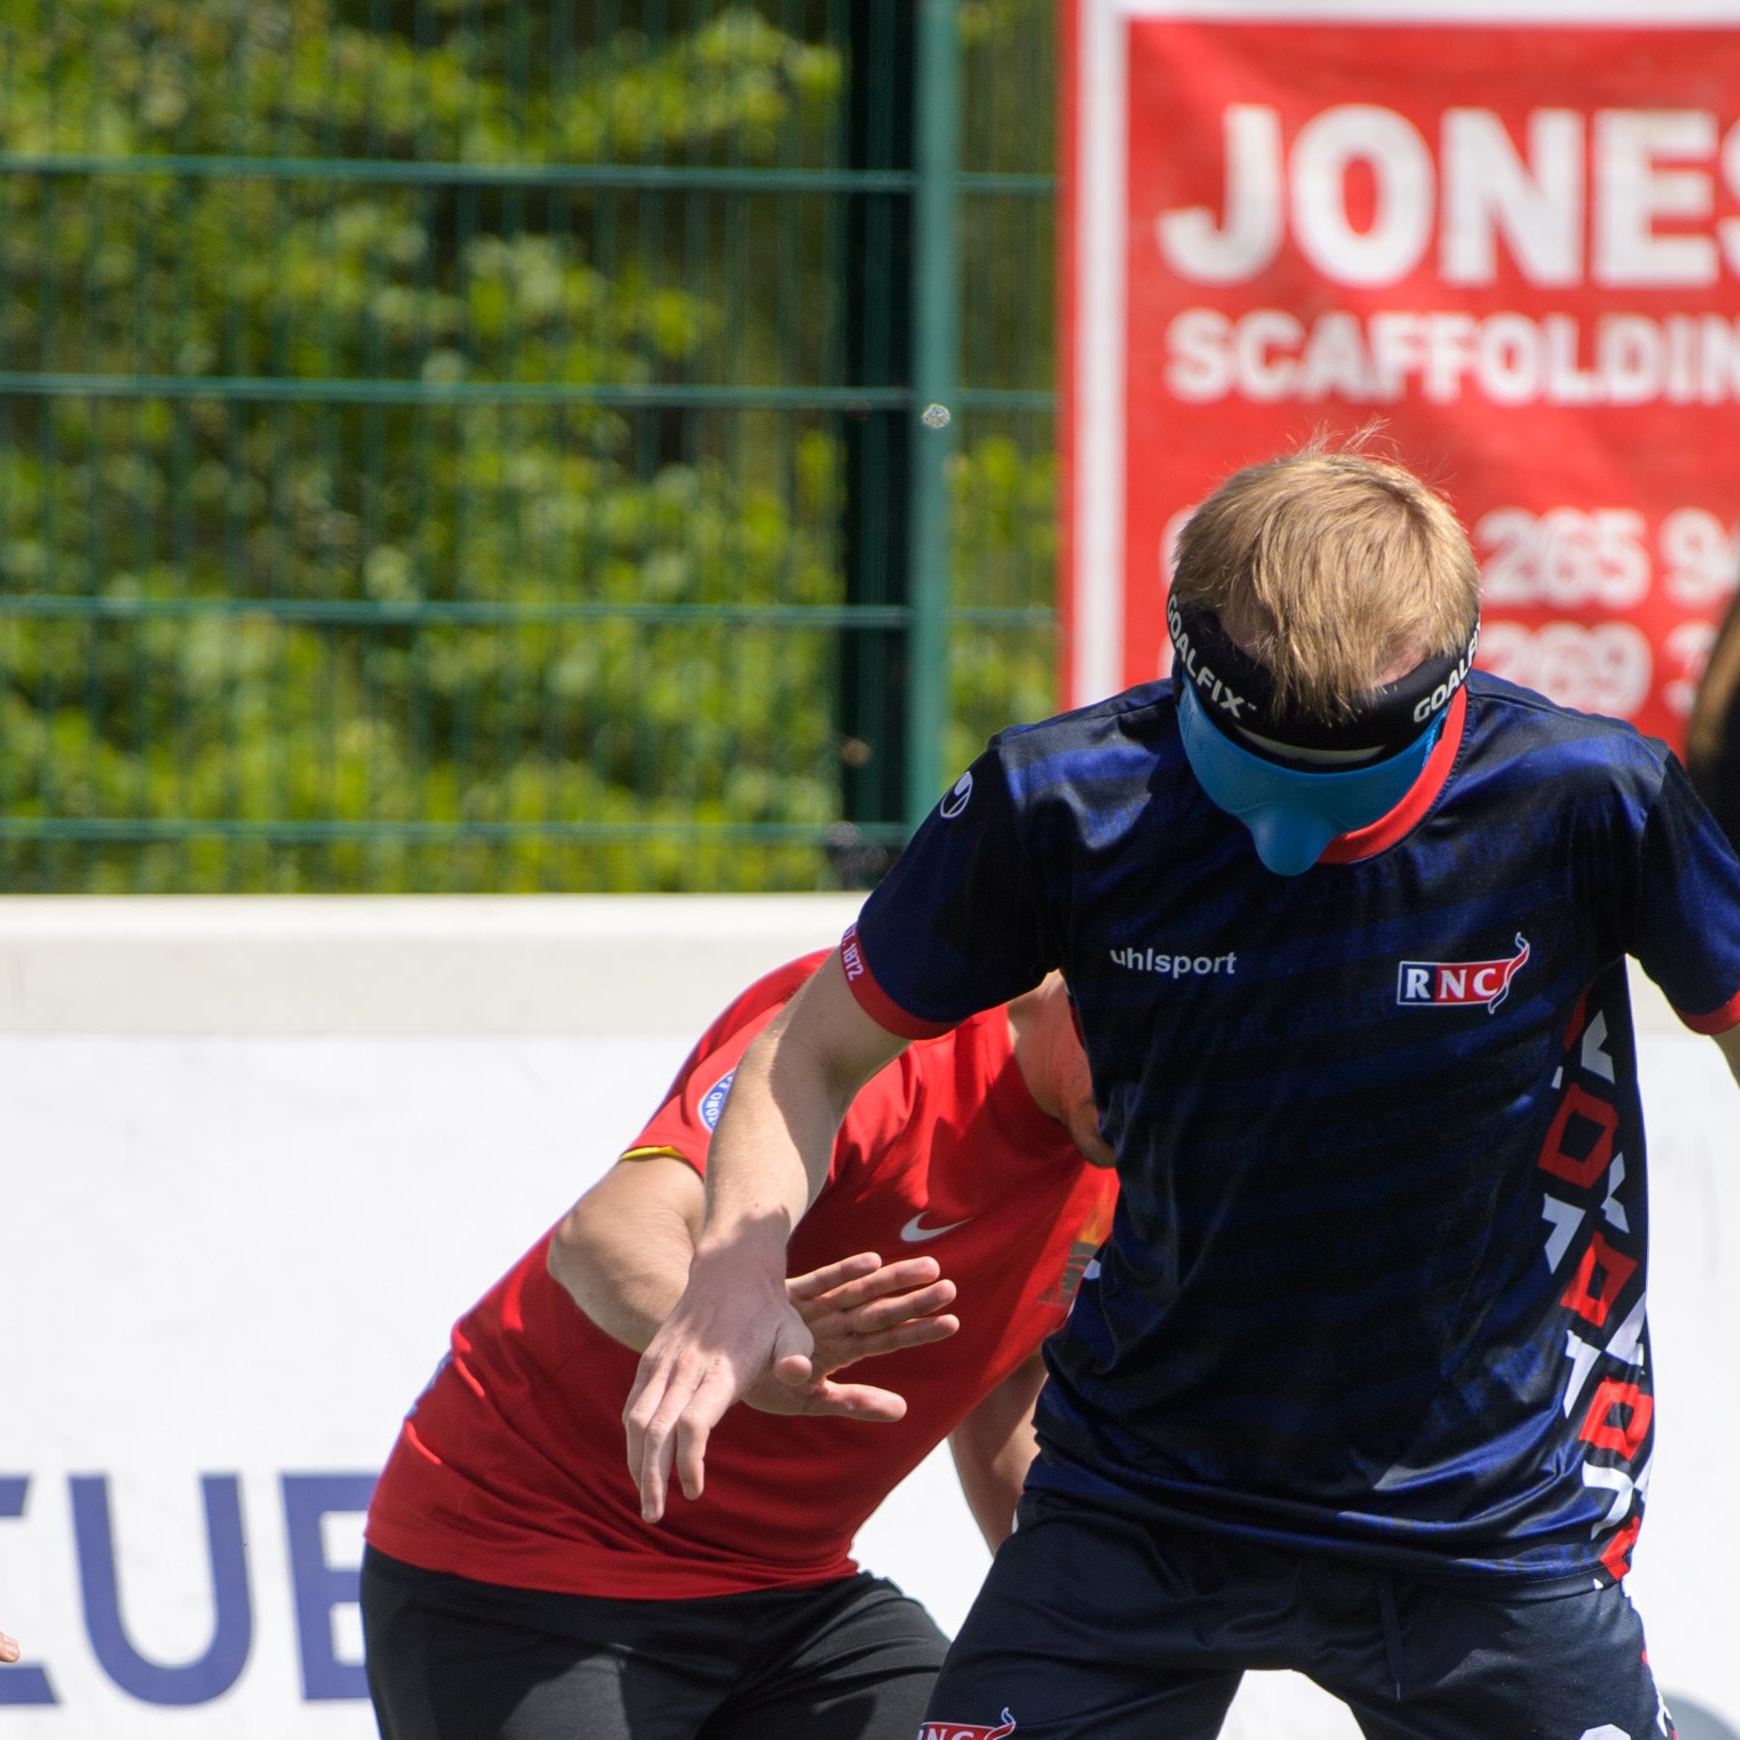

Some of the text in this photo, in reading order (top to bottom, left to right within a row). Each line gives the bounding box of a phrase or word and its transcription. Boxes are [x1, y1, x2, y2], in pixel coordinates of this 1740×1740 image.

[1474, 507, 1652, 606] 265
[843, 943, 864, 982] 1872
[1110, 948, 1237, 979] uhlsport
[1405, 967, 1501, 1000] RNC
